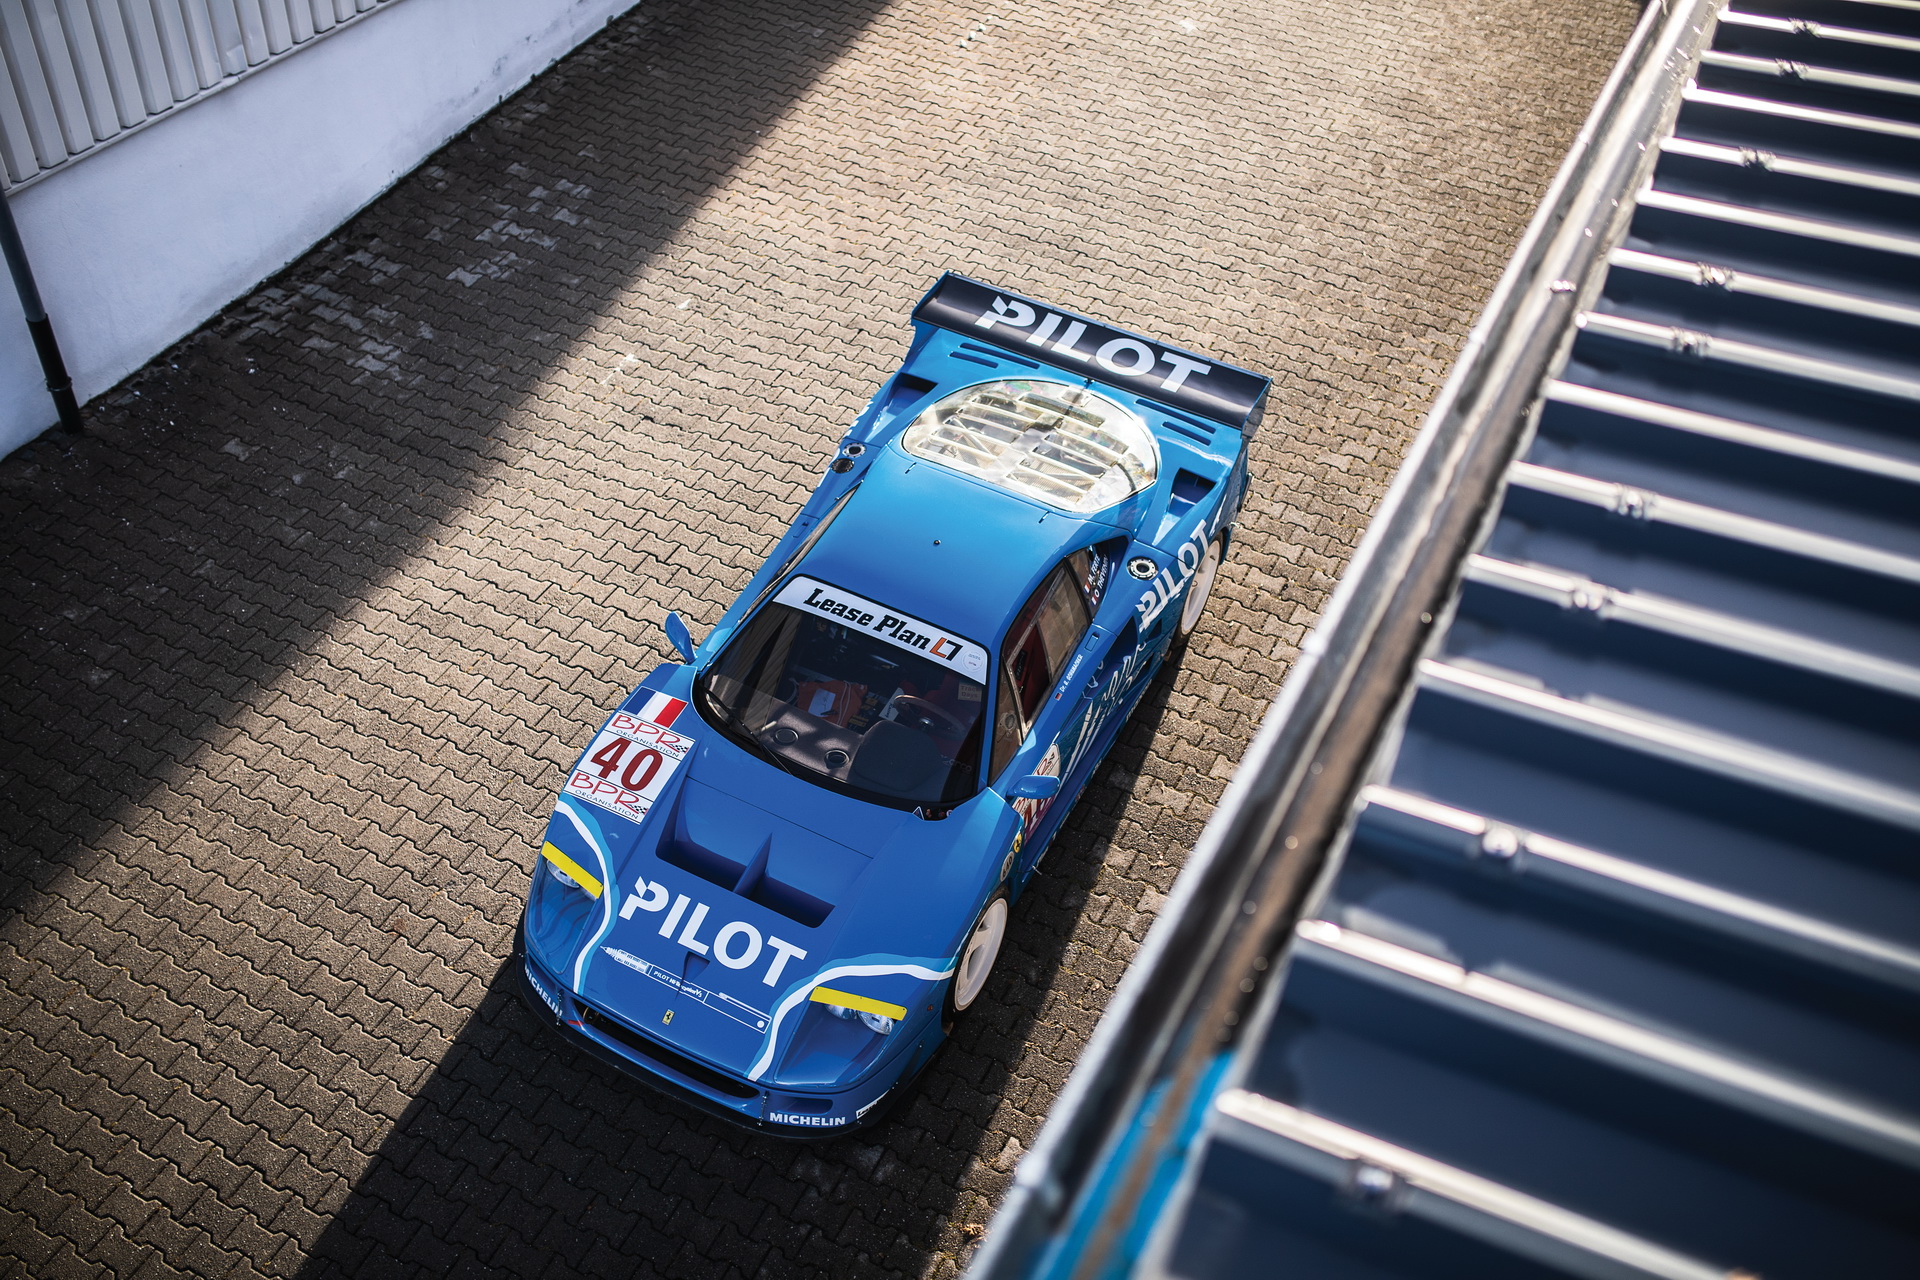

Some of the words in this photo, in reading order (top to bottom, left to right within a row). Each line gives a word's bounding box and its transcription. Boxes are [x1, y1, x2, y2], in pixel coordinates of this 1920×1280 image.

[975, 296, 1211, 393] PILOT
[1135, 519, 1210, 633] PILOT
[803, 588, 875, 626] Lease
[872, 614, 931, 650] Plan
[611, 714, 685, 753] BPR
[616, 729, 680, 758] ORGANISATION
[590, 737, 664, 792] 40
[570, 772, 643, 815] BPR
[575, 789, 639, 820] ORGANISATION
[618, 876, 808, 988] PILOT
[524, 963, 563, 1016] MICHELIN
[653, 970, 670, 982] PILOT
[769, 1112, 846, 1126] MICHELIN
